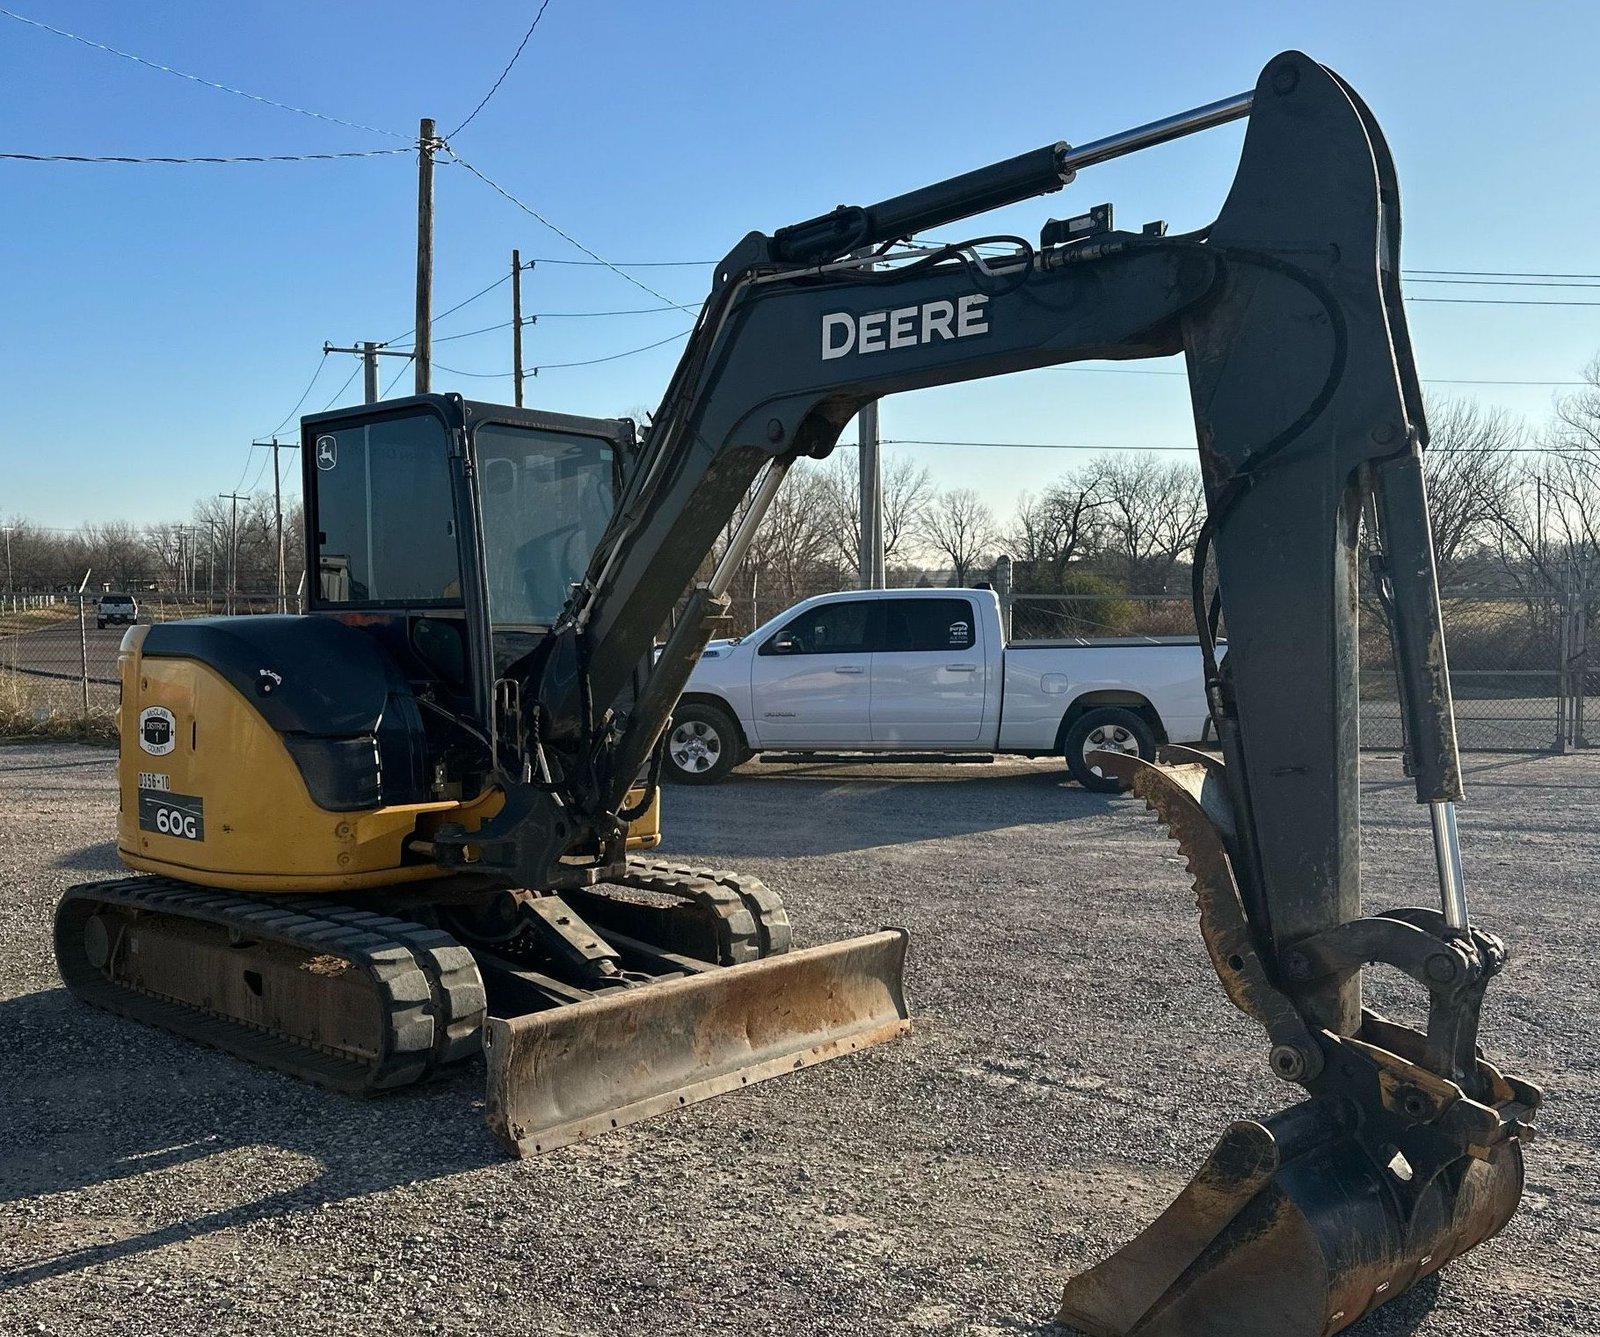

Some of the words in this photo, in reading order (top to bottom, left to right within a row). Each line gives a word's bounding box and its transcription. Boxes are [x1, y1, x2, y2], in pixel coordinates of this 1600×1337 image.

[822, 294, 989, 360] DEERE
[146, 721, 168, 731] DISTRICT
[155, 731, 159, 743] 1
[147, 743, 168, 754] COUNTY
[156, 808, 196, 838] 60G
